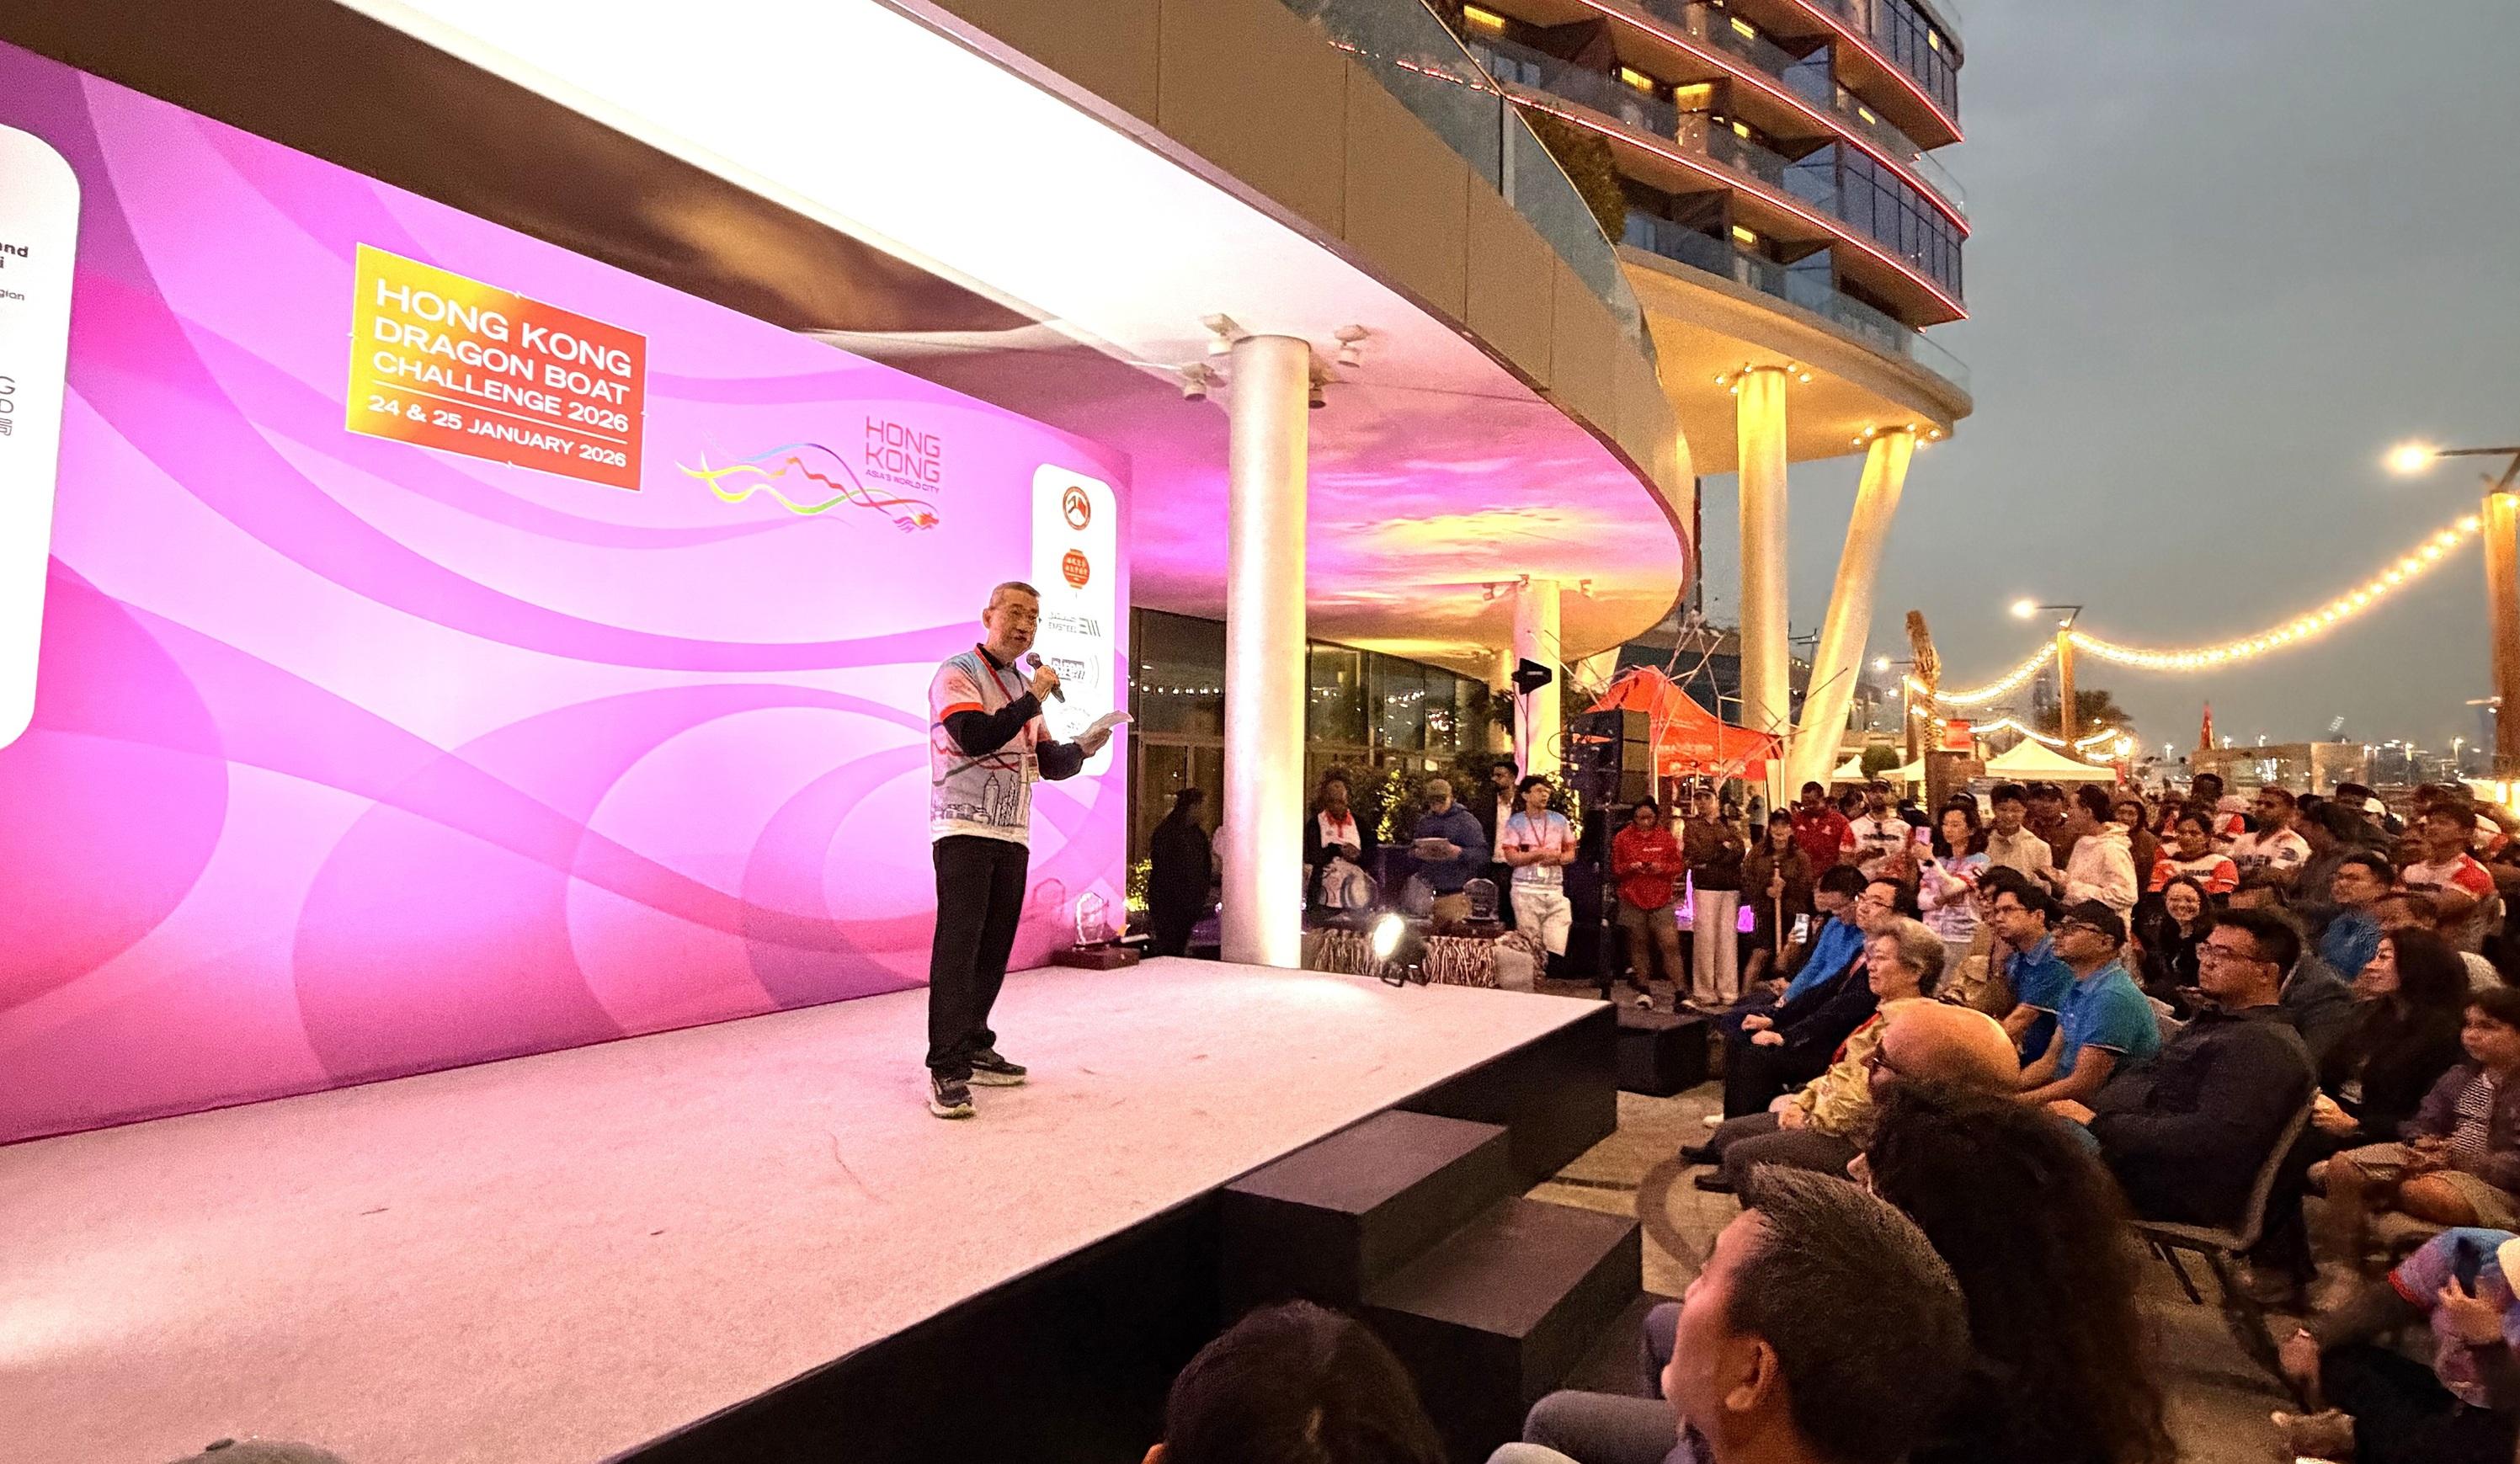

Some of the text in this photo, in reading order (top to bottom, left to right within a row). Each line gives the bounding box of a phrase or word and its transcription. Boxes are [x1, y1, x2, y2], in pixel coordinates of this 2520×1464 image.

[0, 242, 29, 258] nd
[376, 278, 631, 378] HONG KONG
[374, 316, 630, 406] DRAGON BOAT
[373, 351, 629, 433] CHALLENGE 2026
[368, 395, 627, 468] 24 & 25 JANUARY 2026
[866, 416, 940, 458] HONG
[866, 442, 940, 483] KONG
[866, 469, 940, 493] ASIA'S WORLD CITY
